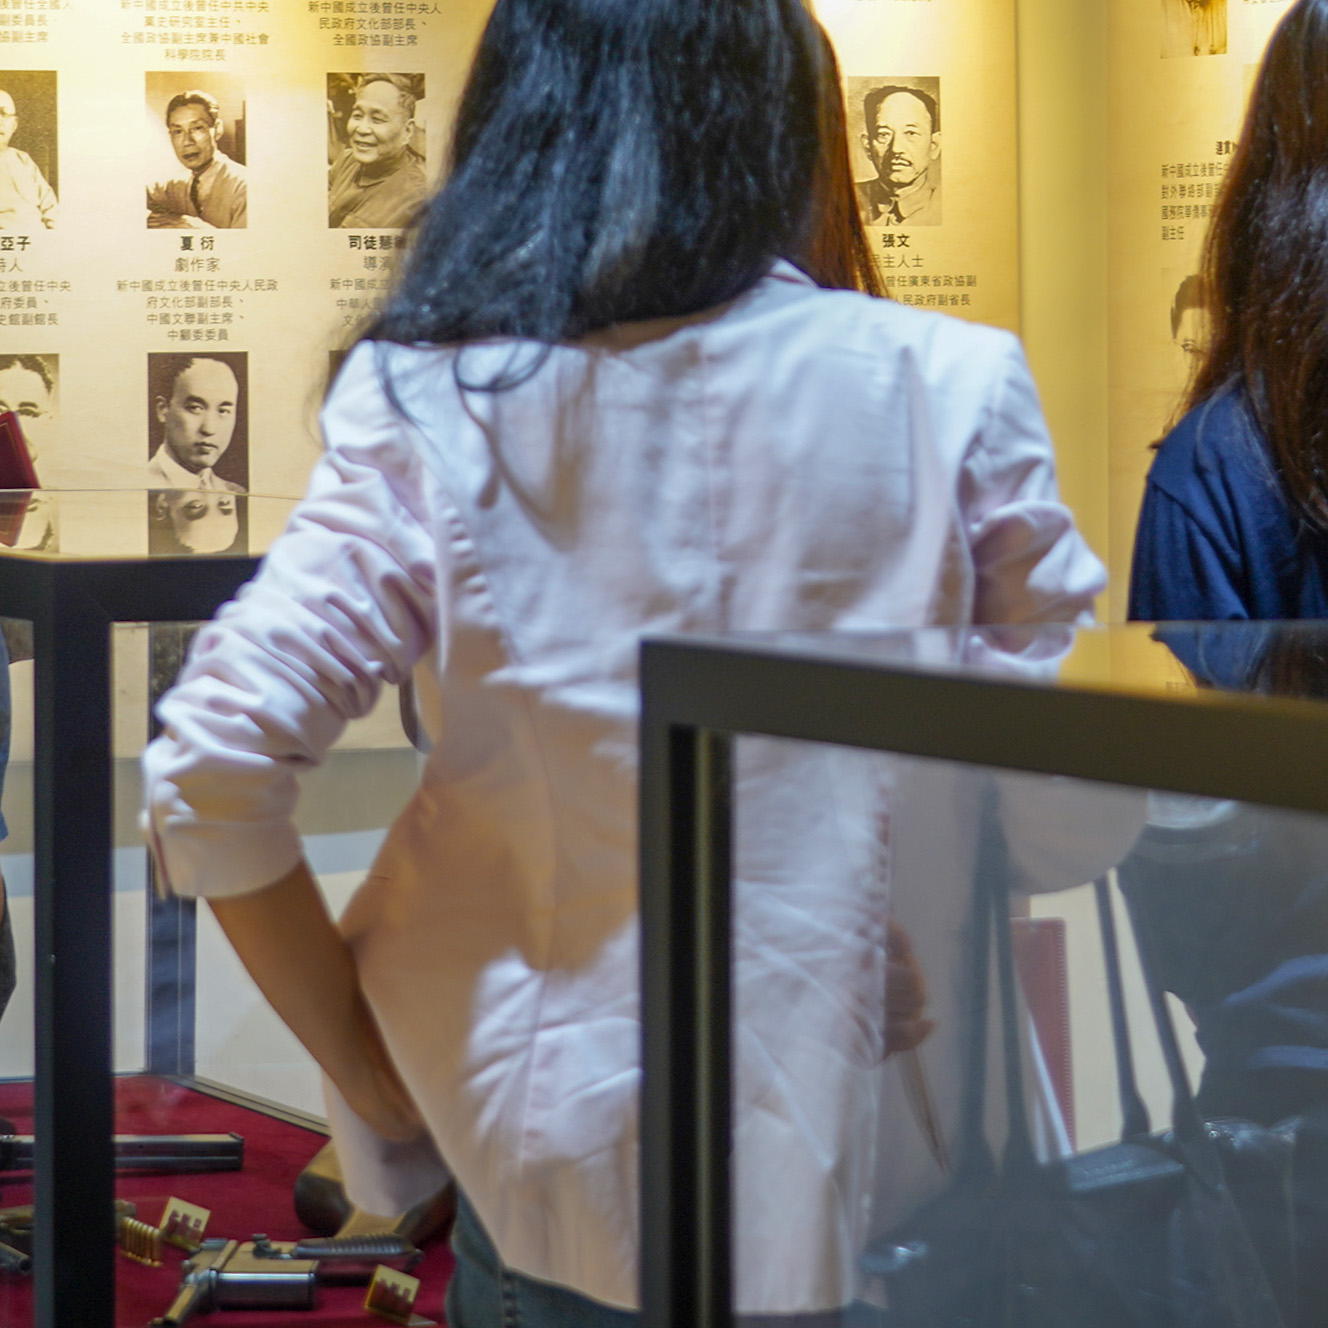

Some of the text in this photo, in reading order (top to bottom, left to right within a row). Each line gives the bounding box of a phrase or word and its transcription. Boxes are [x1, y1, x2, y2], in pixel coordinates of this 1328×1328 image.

[308, 1, 442, 15] 新中國成立後曾任中央人
[333, 34, 418, 47] 全國政協副主席
[882, 233, 910, 248] 張文
[174, 257, 221, 272] 劇作家
[116, 279, 279, 292] 新中國成立後曾任中央人民政
